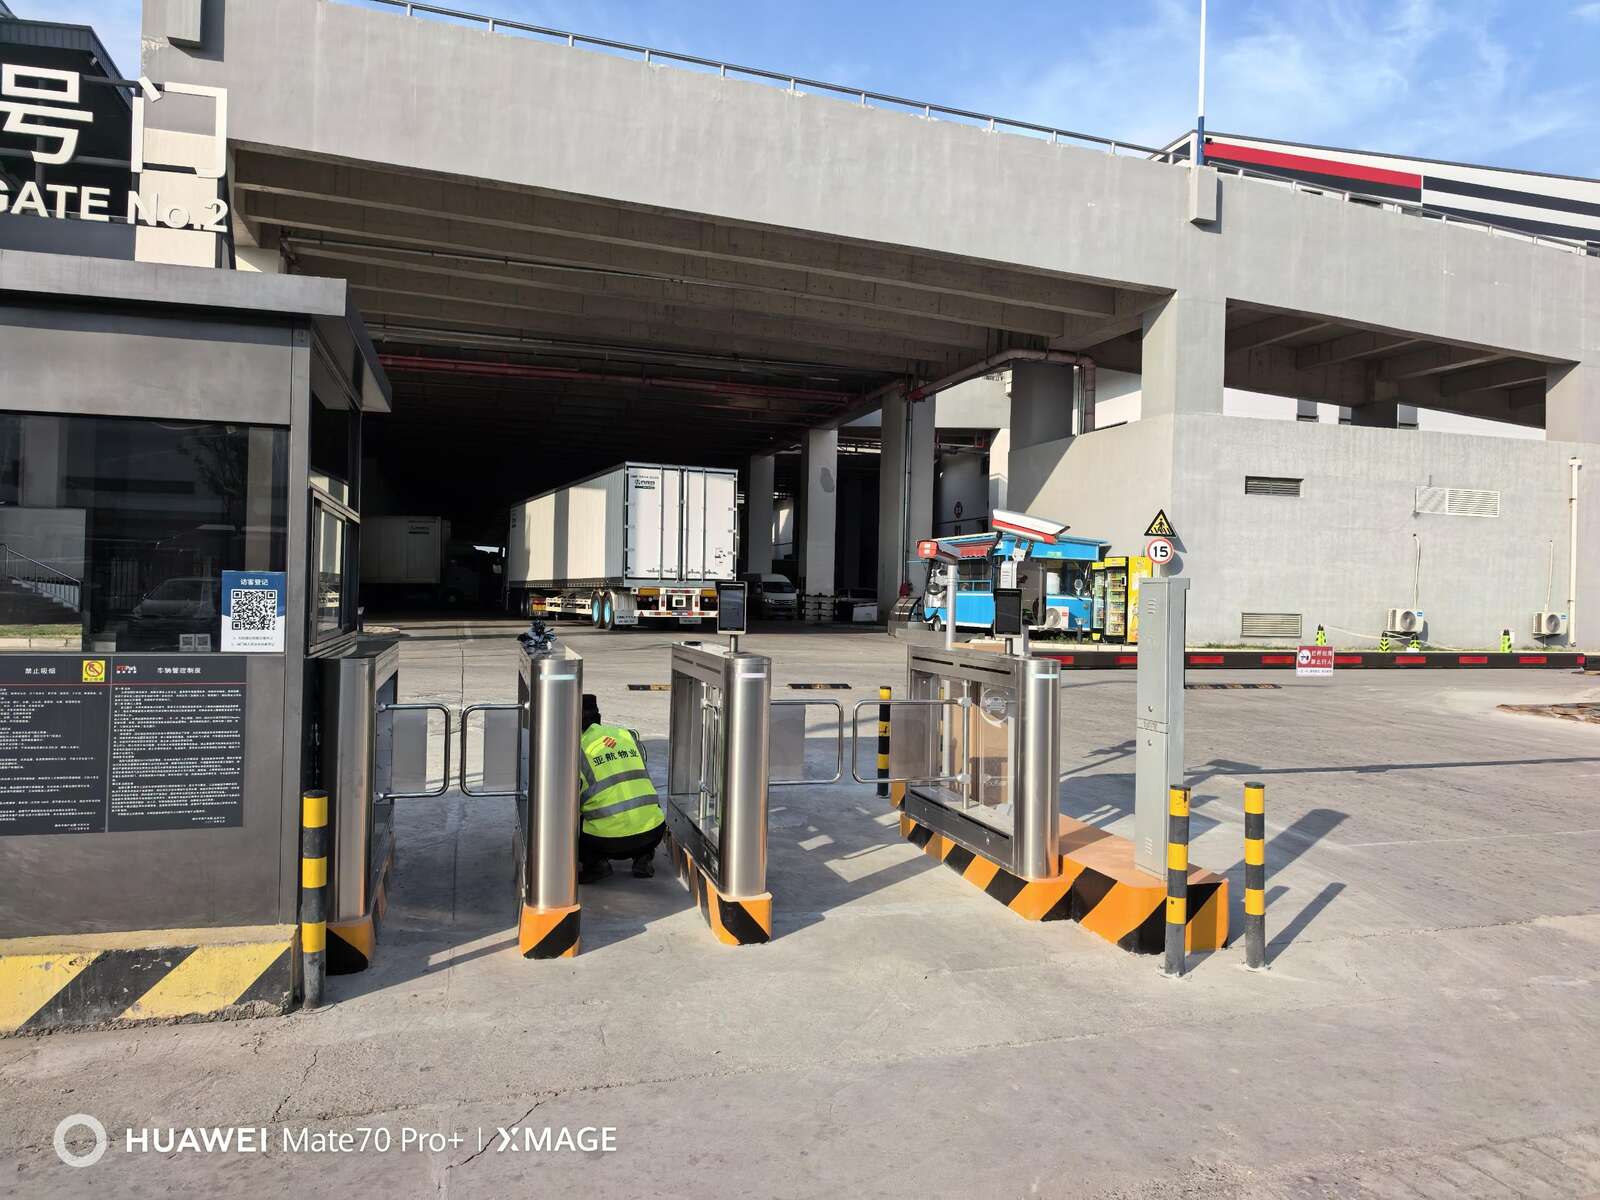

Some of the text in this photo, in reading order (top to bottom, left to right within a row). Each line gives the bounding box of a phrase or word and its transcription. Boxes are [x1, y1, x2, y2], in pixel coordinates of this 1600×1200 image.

[0, 63, 228, 178] 号门
[127, 190, 228, 233] No.2
[1153, 546, 1168, 557] 15
[240, 578, 269, 586] 访客登记
[593, 750, 639, 766] 亚航物业
